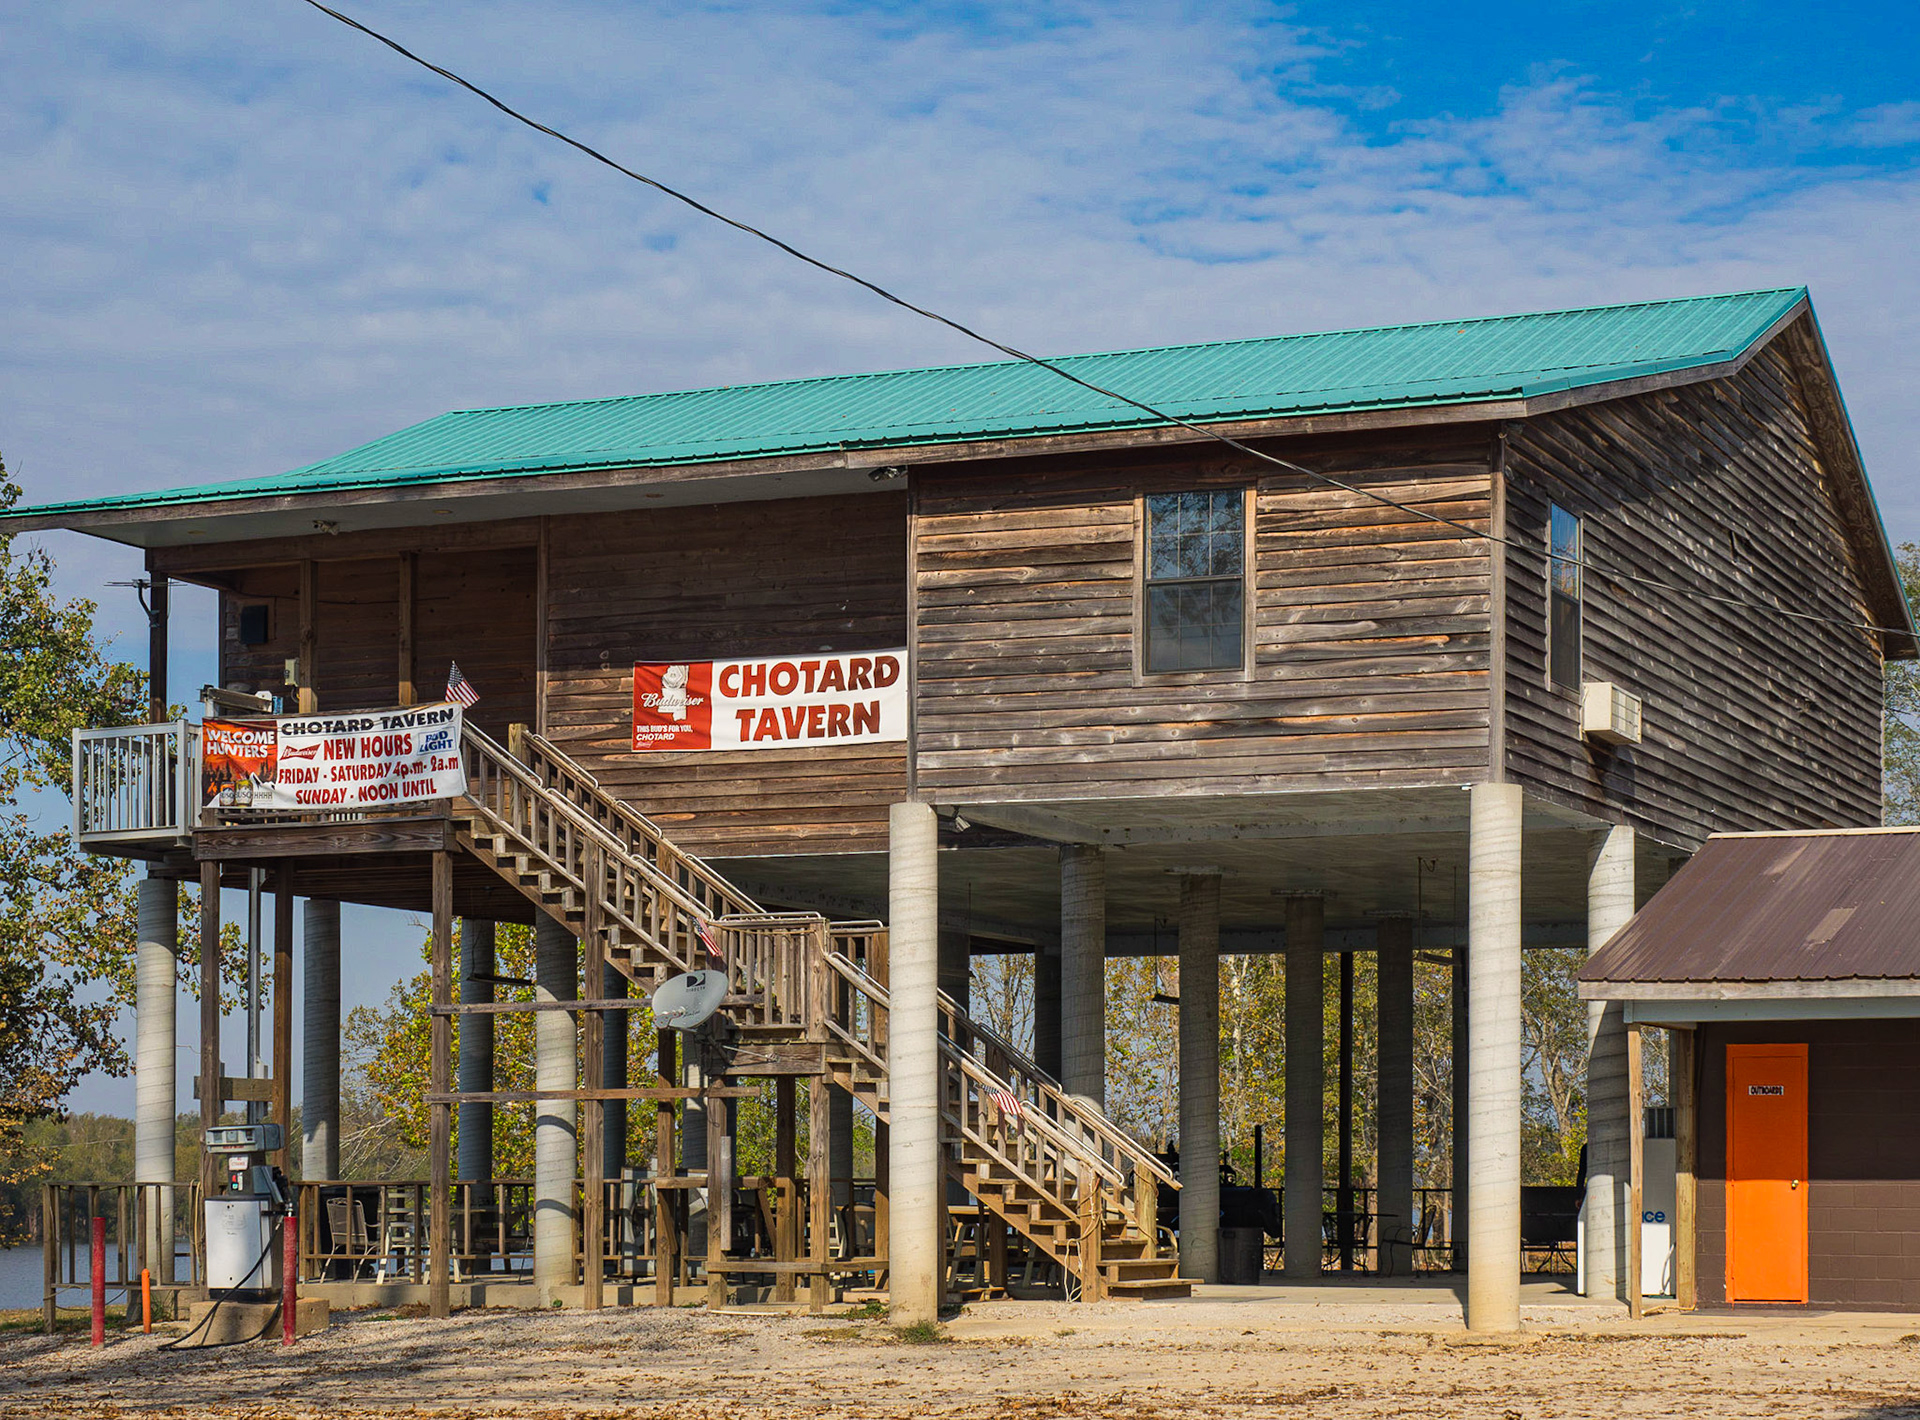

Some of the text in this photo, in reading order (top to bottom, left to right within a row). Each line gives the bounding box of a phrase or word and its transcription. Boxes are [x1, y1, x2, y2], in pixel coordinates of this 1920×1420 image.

[719, 655, 900, 698] CHOTARD
[641, 693, 704, 708] Budweiser
[281, 708, 454, 736] CHOTARD TAVERN
[636, 725, 649, 733] THIS
[736, 700, 880, 742] TAVERN
[206, 728, 275, 745] WELCOME
[425, 730, 449, 741] BUD
[636, 733, 675, 741] CHOTARD
[207, 742, 268, 758] HUNTERS
[283, 746, 318, 758] Budweiser
[324, 733, 413, 761] NEW HOURS
[419, 739, 454, 753] LIGHT
[278, 767, 320, 784] FRIDAY
[331, 762, 392, 782] SATURDAY
[296, 788, 347, 805] SUNDAY
[358, 783, 399, 802] NOON
[403, 778, 437, 798] UNTIL
[1750, 1086, 1783, 1096] OUTBOARDS
